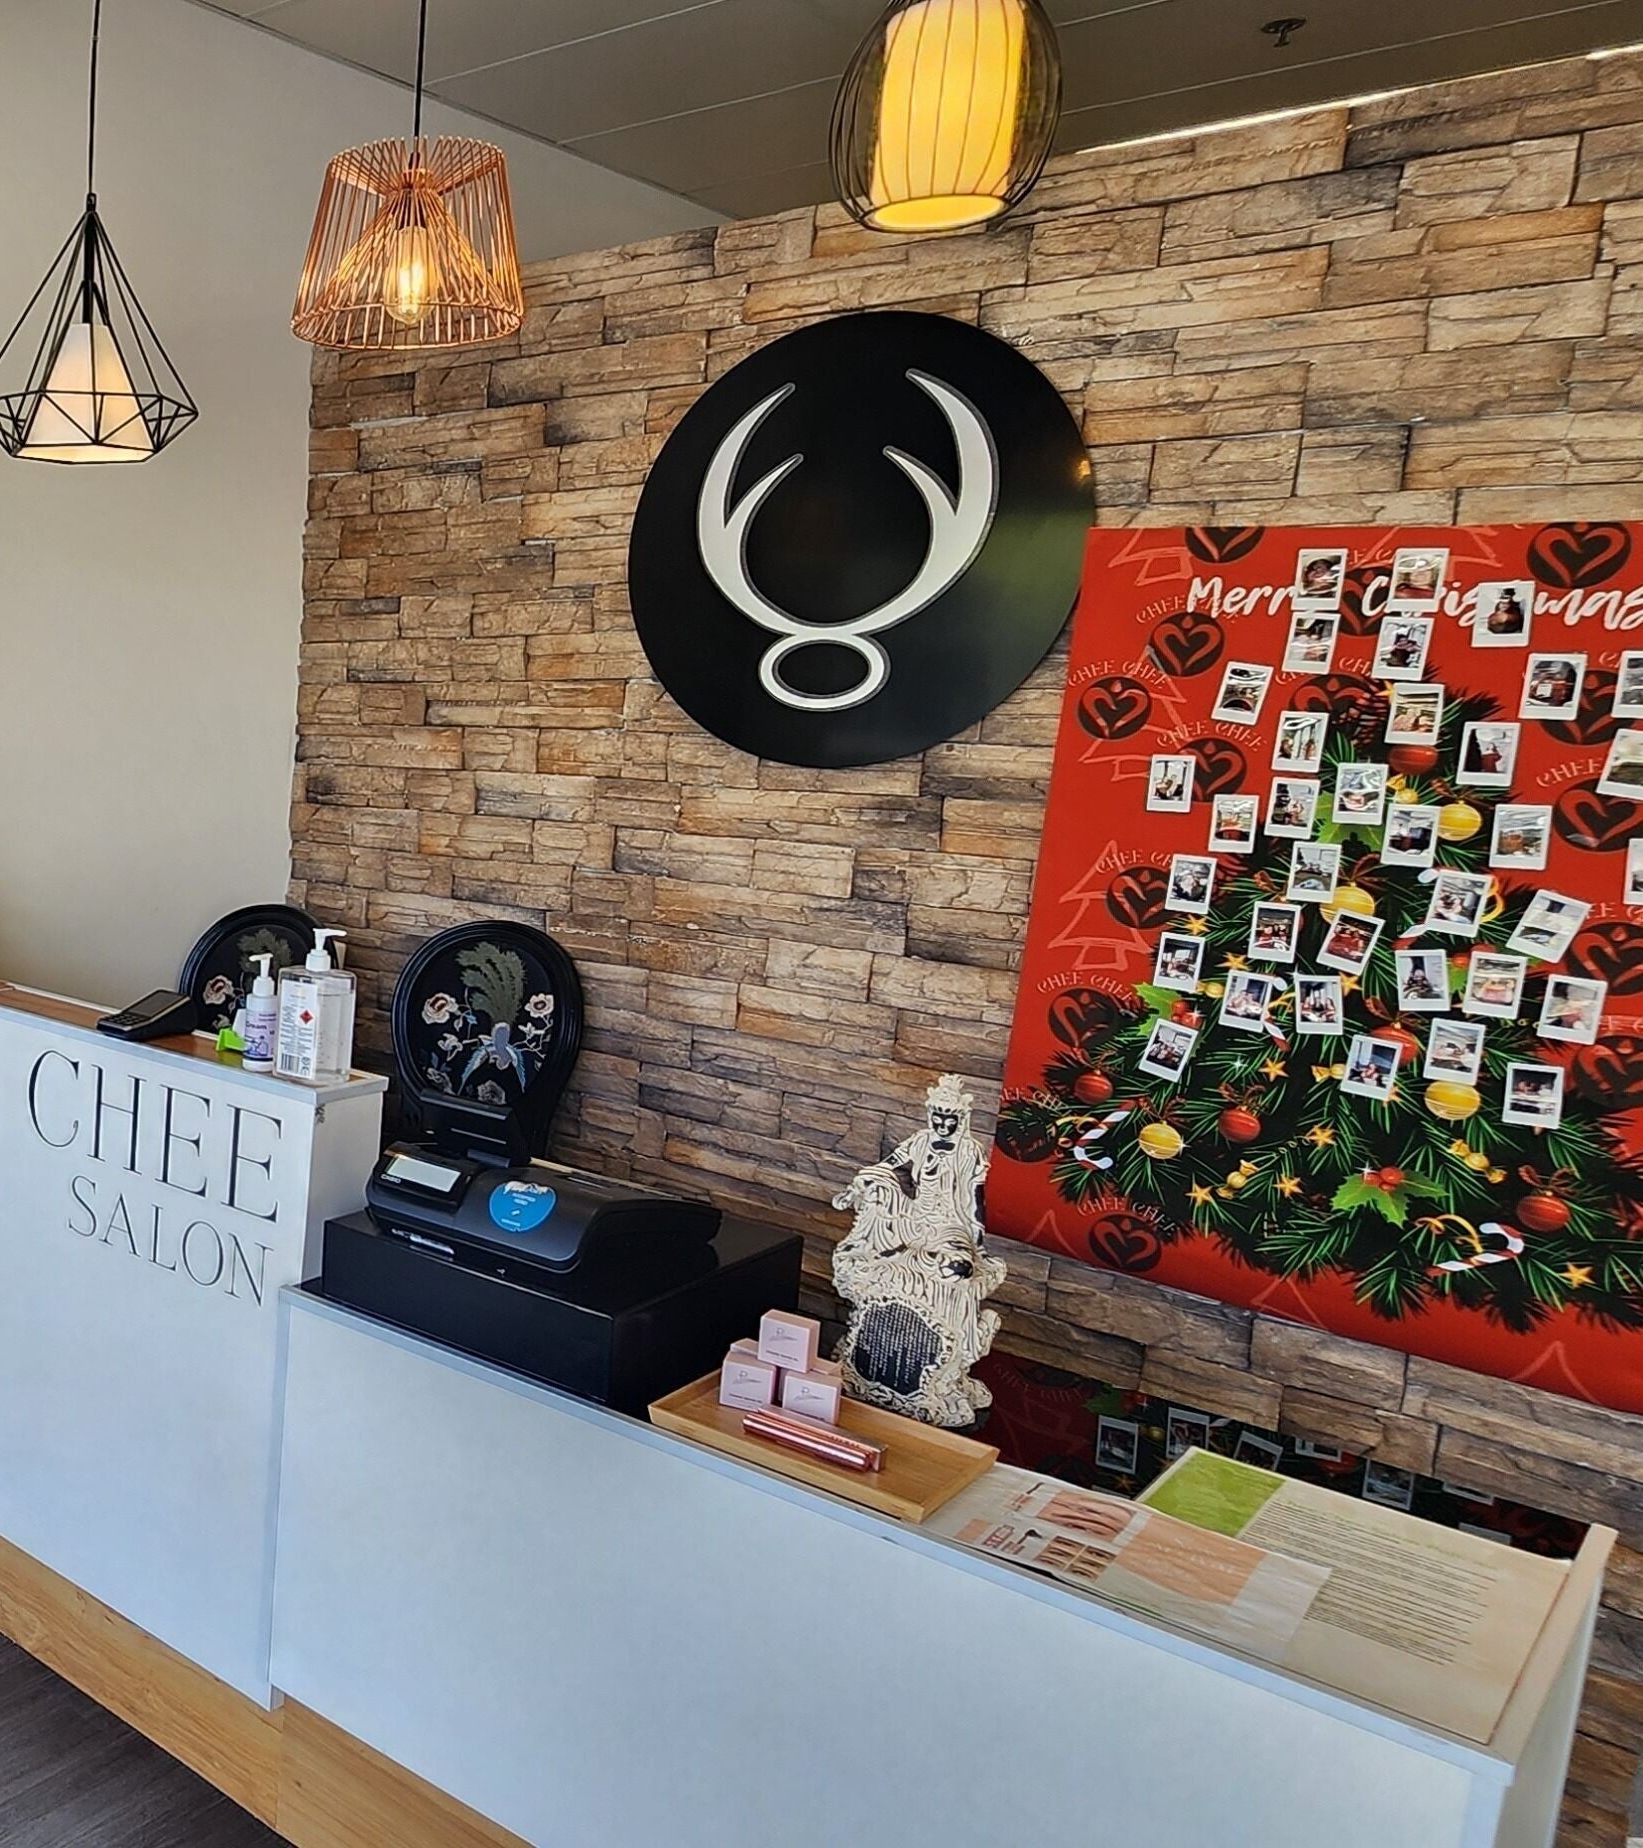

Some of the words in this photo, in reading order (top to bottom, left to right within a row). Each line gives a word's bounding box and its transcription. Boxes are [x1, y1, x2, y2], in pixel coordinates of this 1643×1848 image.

[1187, 576, 1320, 619] Merr
[1362, 575, 1643, 633] Cismas
[1068, 659, 1116, 687] CHEE
[1122, 659, 1169, 690] CHEE
[1157, 719, 1209, 748] CHEE
[1215, 721, 1268, 752] CHEE
[1095, 849, 1144, 874] CHEE
[1037, 971, 1085, 995] CHEE
[27, 1049, 284, 1223] CHEE
[1077, 1197, 1127, 1217] CHEE
[67, 1174, 274, 1308] SALON
